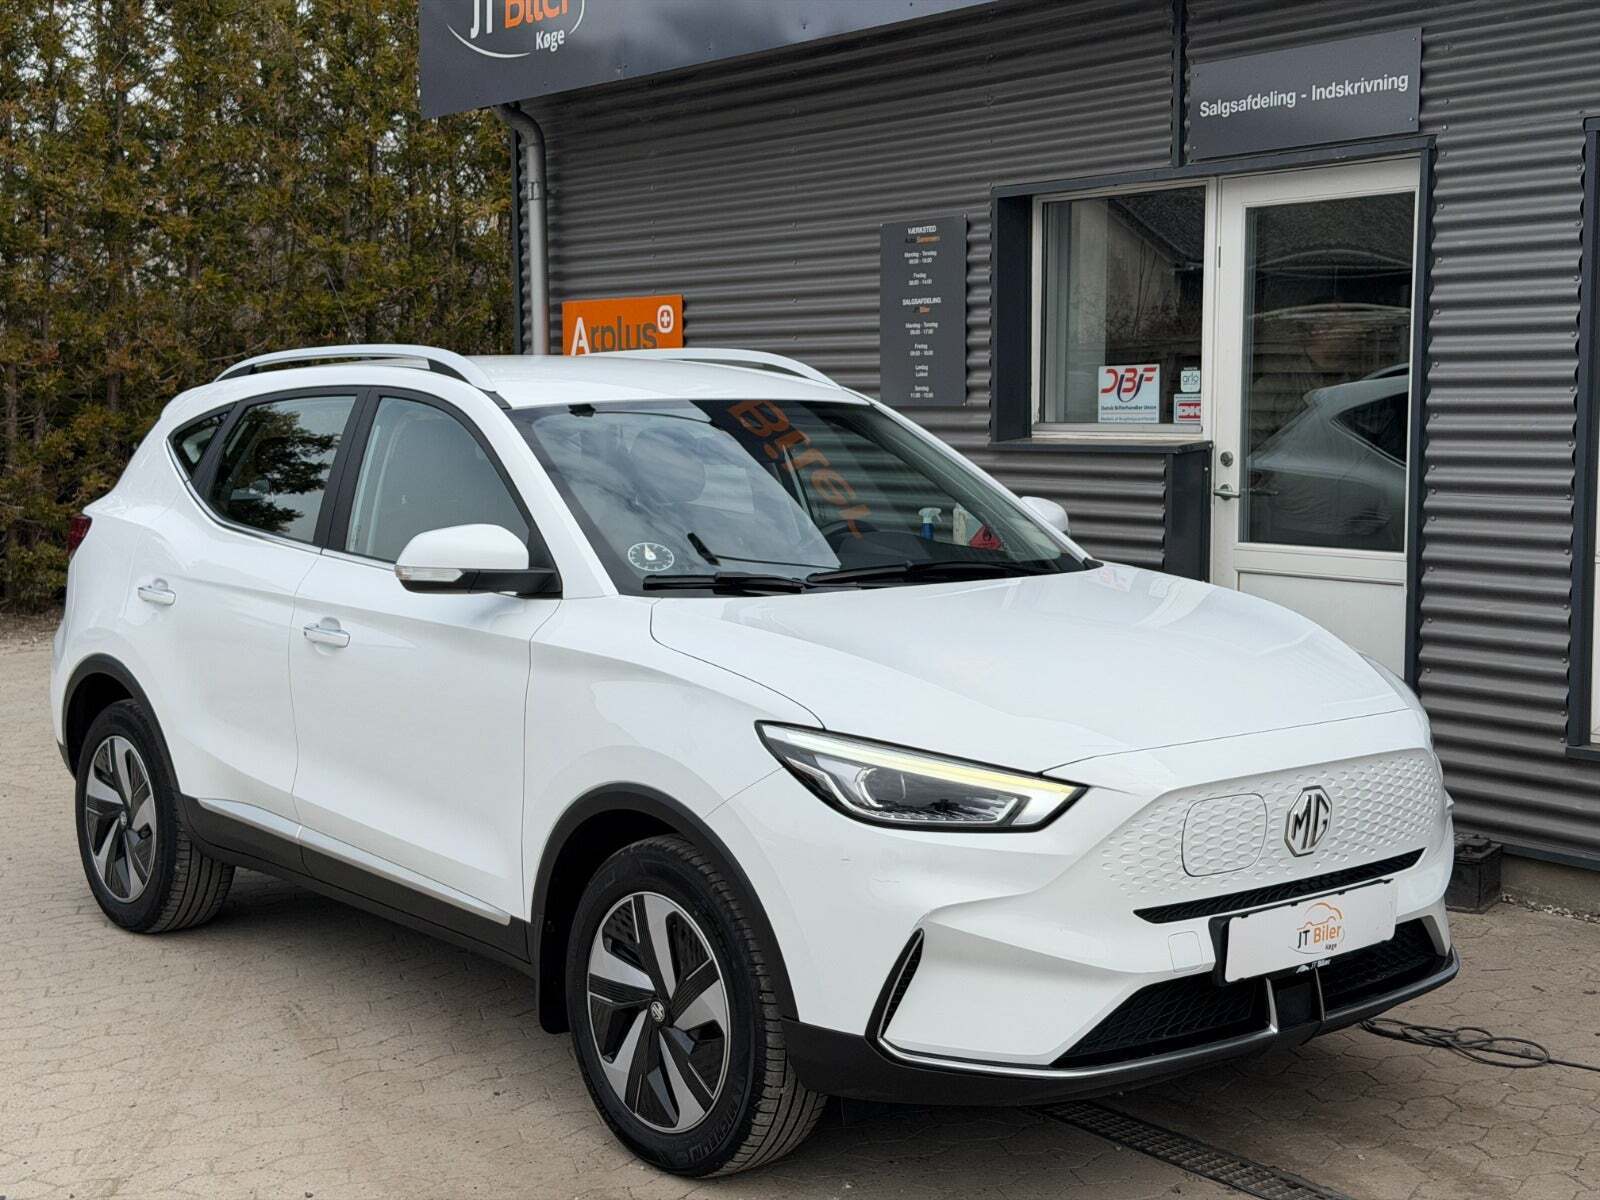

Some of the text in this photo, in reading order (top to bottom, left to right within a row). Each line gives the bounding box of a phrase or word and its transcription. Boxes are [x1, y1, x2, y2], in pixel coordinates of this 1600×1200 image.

[535, 29, 566, 53] Køge
[1199, 90, 1297, 118] Salgsafdeling
[1311, 73, 1410, 102] Indskrivning
[1290, 794, 1330, 850] MG
[1297, 924, 1342, 949] JT Biler
